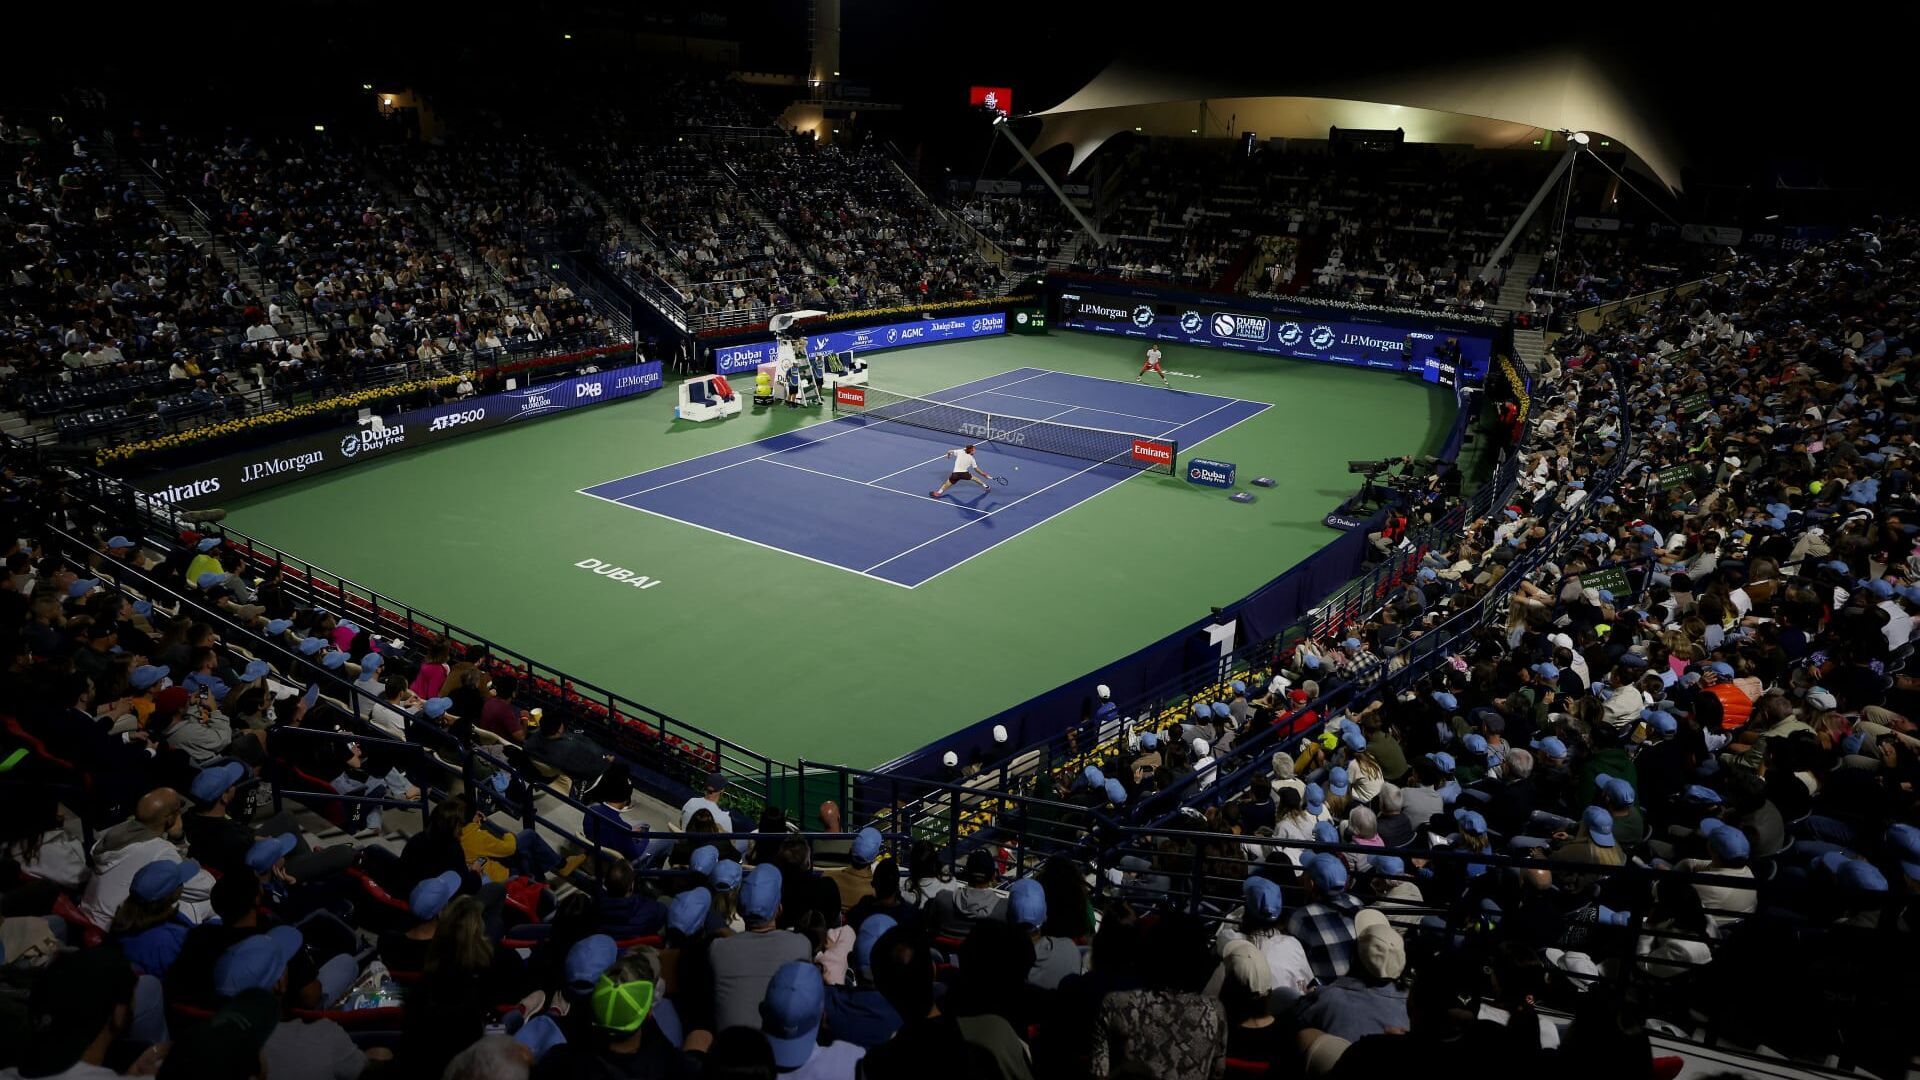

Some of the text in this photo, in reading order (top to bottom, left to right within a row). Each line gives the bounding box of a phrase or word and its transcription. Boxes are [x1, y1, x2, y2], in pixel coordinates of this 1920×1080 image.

[1078, 303, 1128, 319] J.P.Morgan
[982, 317, 1003, 326] Dubai
[1236, 316, 1266, 327] DUBAI
[901, 327, 924, 339] AGMC
[1341, 333, 1404, 351] J.P.Morgan
[734, 350, 762, 361] Dubai
[616, 372, 659, 389] J.P.Morgan
[576, 382, 602, 398] DXB
[838, 390, 864, 402] Emirates
[528, 395, 544, 403] Win
[361, 425, 404, 443] Dubai
[958, 422, 1025, 445] ATP TOUR
[362, 434, 405, 452] Duty Free
[1134, 445, 1170, 459] Emirates
[241, 450, 324, 482] J.P.Morgan
[1201, 469, 1226, 480] Dubai
[145, 477, 221, 508] mirates
[574, 558, 662, 590] DUBAI
